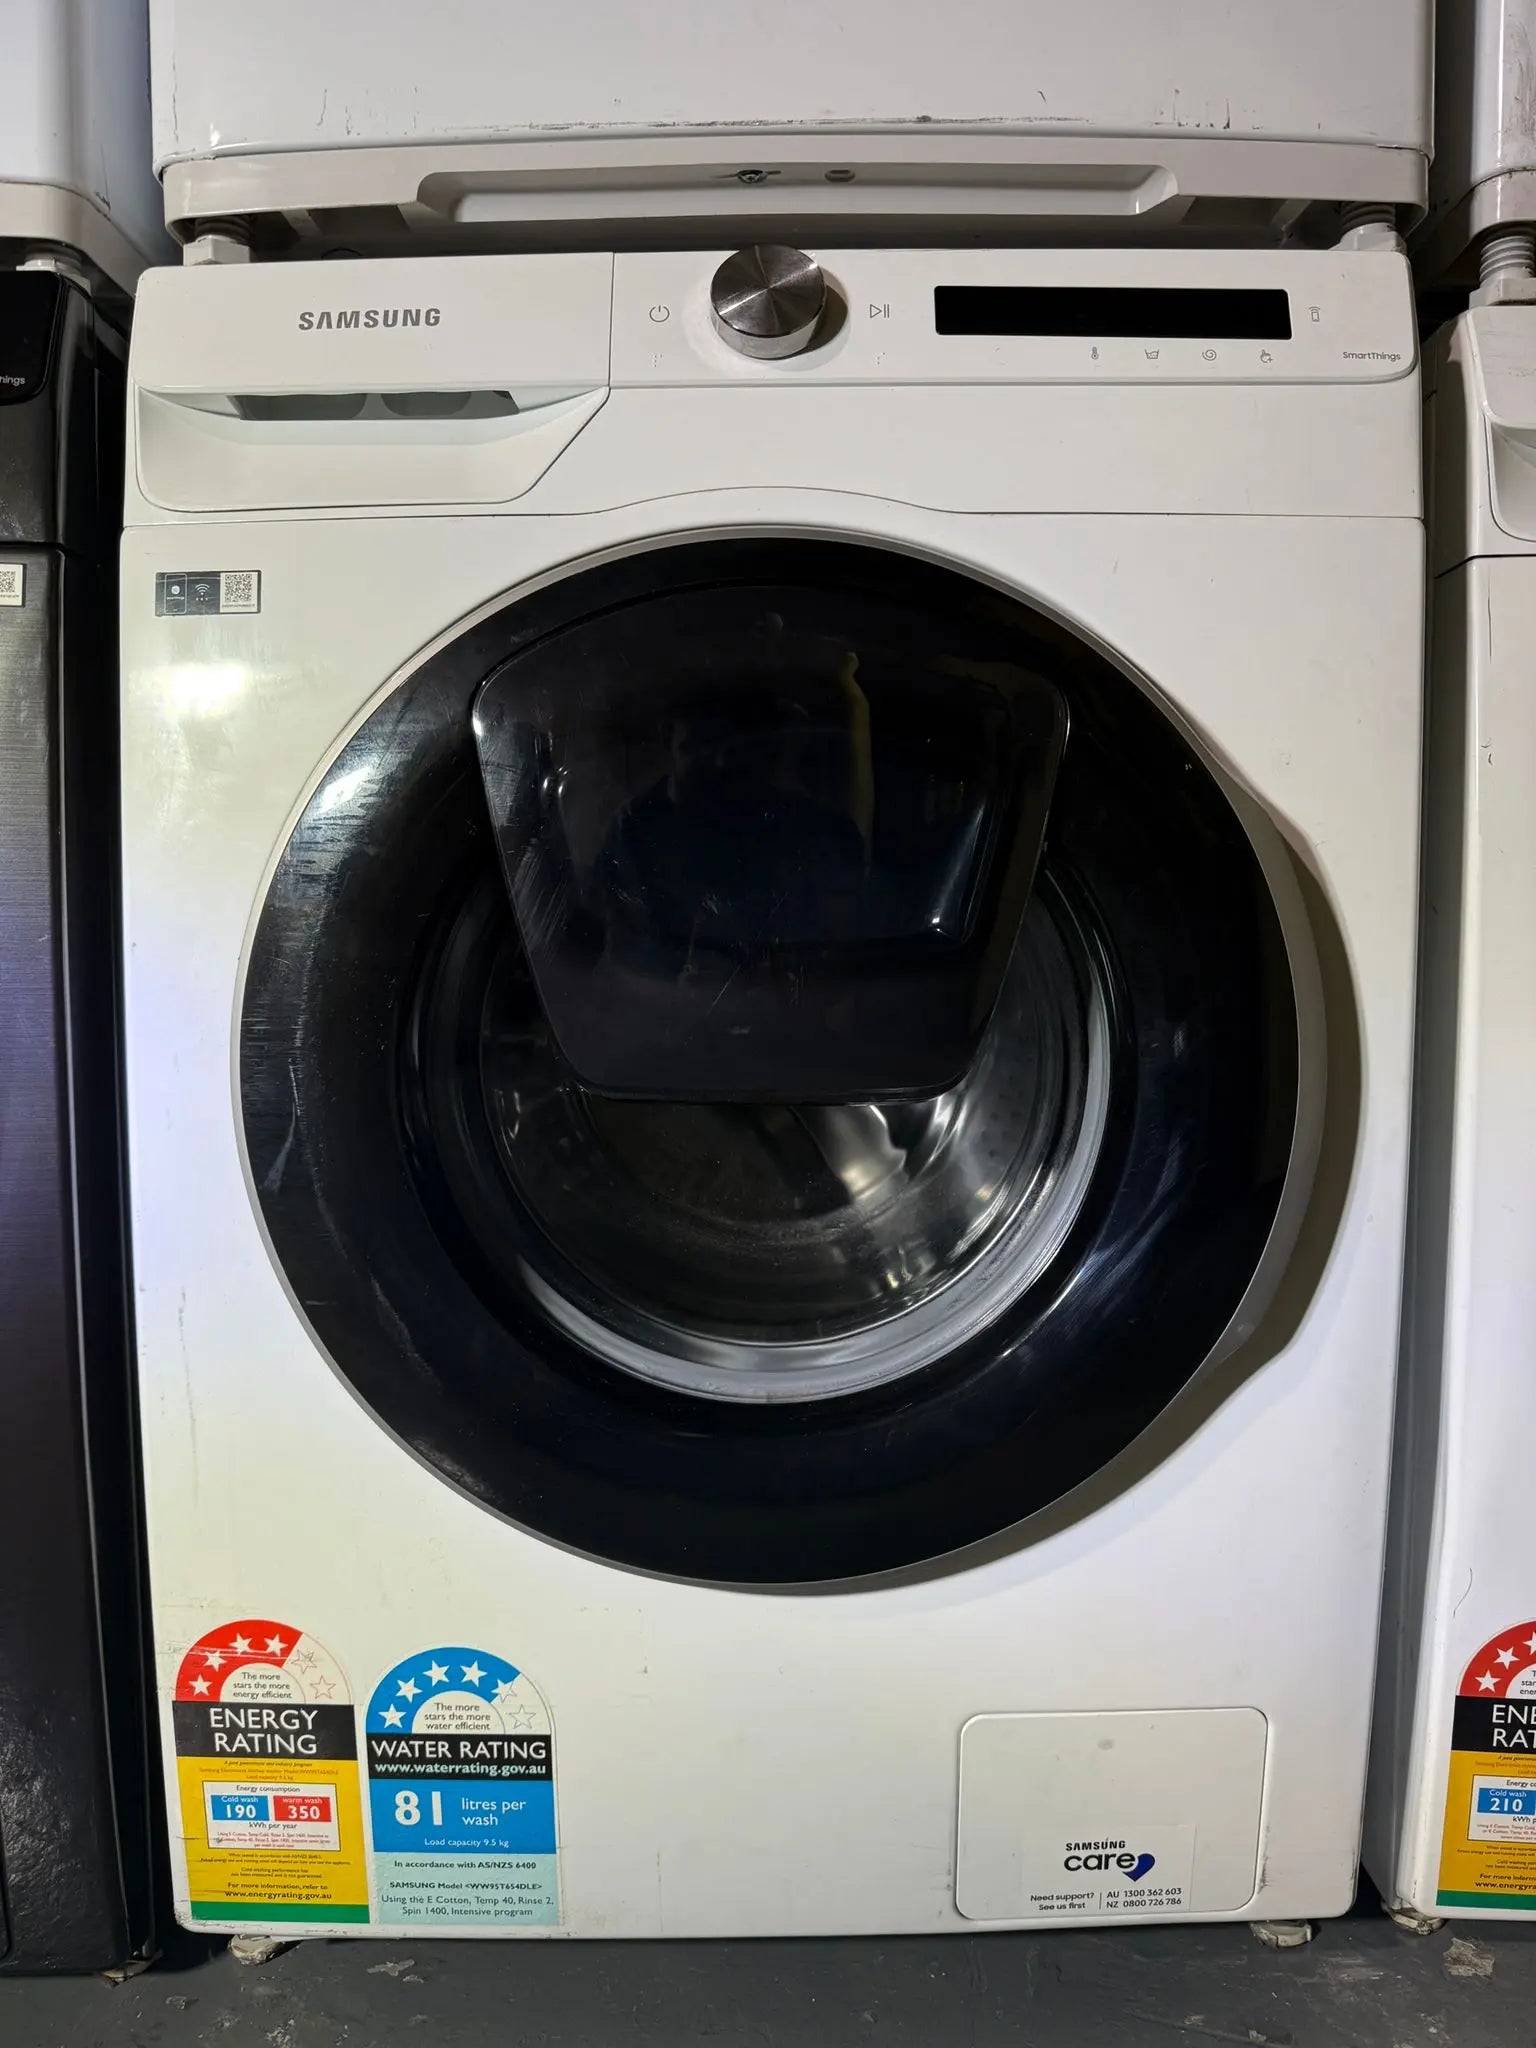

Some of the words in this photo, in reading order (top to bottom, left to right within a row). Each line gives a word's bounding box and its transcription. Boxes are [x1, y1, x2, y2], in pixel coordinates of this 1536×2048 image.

[298, 308, 441, 331] SAMSUNG
[1343, 352, 1401, 362] SmartThings
[242, 1672, 257, 1680] The
[233, 1691, 259, 1699] energy
[261, 1690, 292, 1699] efficient
[434, 1703, 452, 1711] The
[209, 1708, 319, 1730] ENERGY
[449, 1713, 464, 1721] the
[455, 1722, 490, 1730] efficient
[214, 1732, 317, 1755] RATING
[371, 1740, 452, 1759] WATER
[460, 1741, 546, 1760] RATING
[375, 1762, 546, 1777] www.waterrating.gov.au
[1506, 1779, 1528, 1788] Energy
[236, 1785, 258, 1793] Energy
[259, 1785, 300, 1793] consumption
[1509, 1790, 1527, 1798] wash
[462, 1797, 497, 1810] litres
[502, 1800, 526, 1814] per
[1490, 1797, 1523, 1812] 210
[226, 1804, 257, 1819] 190
[288, 1804, 320, 1819] 350
[462, 1813, 498, 1826] wash
[424, 1838, 446, 1846] Load
[447, 1838, 481, 1848] capacity
[483, 1838, 496, 1846] 9.5
[499, 1839, 509, 1848] kg
[1065, 1840, 1126, 1851] SAMSUNG
[394, 1860, 403, 1868] In
[1064, 1853, 1136, 1872] care
[389, 1881, 436, 1889] SAMSUNG
[224, 1890, 332, 1900] www.energyrating.gov.au
[1030, 1894, 1054, 1902] Need
[1055, 1892, 1095, 1902] support?
[1124, 1889, 1145, 1897] 1300
[1147, 1888, 1163, 1896] 362
[1165, 1887, 1182, 1896] 603
[381, 1894, 408, 1905] Using
[409, 1895, 425, 1904] the
[427, 1895, 433, 1903] E
[436, 1895, 472, 1905] Cotton,
[474, 1896, 500, 1906] Temp
[518, 1896, 543, 1904] Rinse
[1123, 1899, 1147, 1908] 0800
[1148, 1898, 1164, 1906] 726
[1166, 1897, 1182, 1905] 786
[402, 1906, 422, 1916] Spin
[451, 1907, 491, 1916] Intensive
[494, 1909, 533, 1917] program
